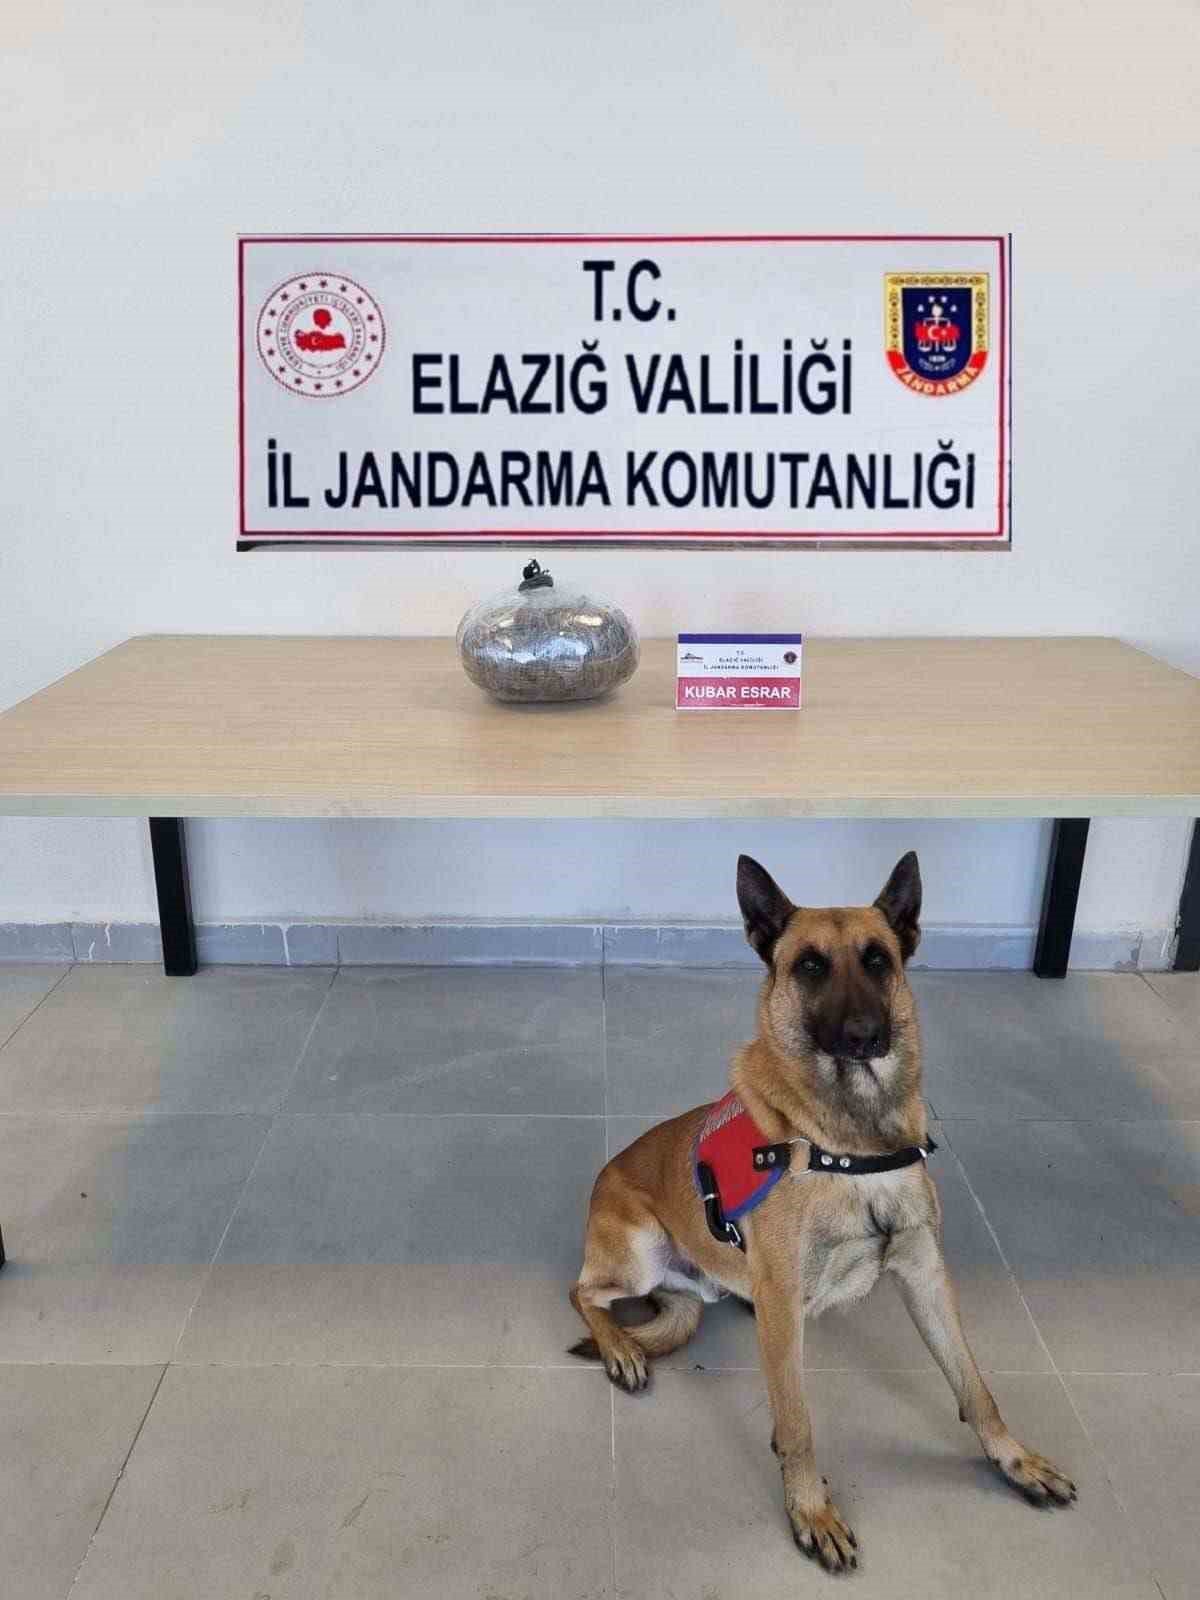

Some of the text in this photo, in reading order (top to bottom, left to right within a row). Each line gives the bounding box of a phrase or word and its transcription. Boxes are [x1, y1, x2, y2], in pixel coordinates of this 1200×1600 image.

[582, 259, 676, 322] T.C.
[412, 338, 852, 415] ELAZIĞ VALİLİĞİ
[895, 367, 979, 395] JANDARMA
[267, 438, 975, 510] İL JANDARMA KOMUTANLIĞI
[684, 686, 791, 699] KUBAR ESRAR
